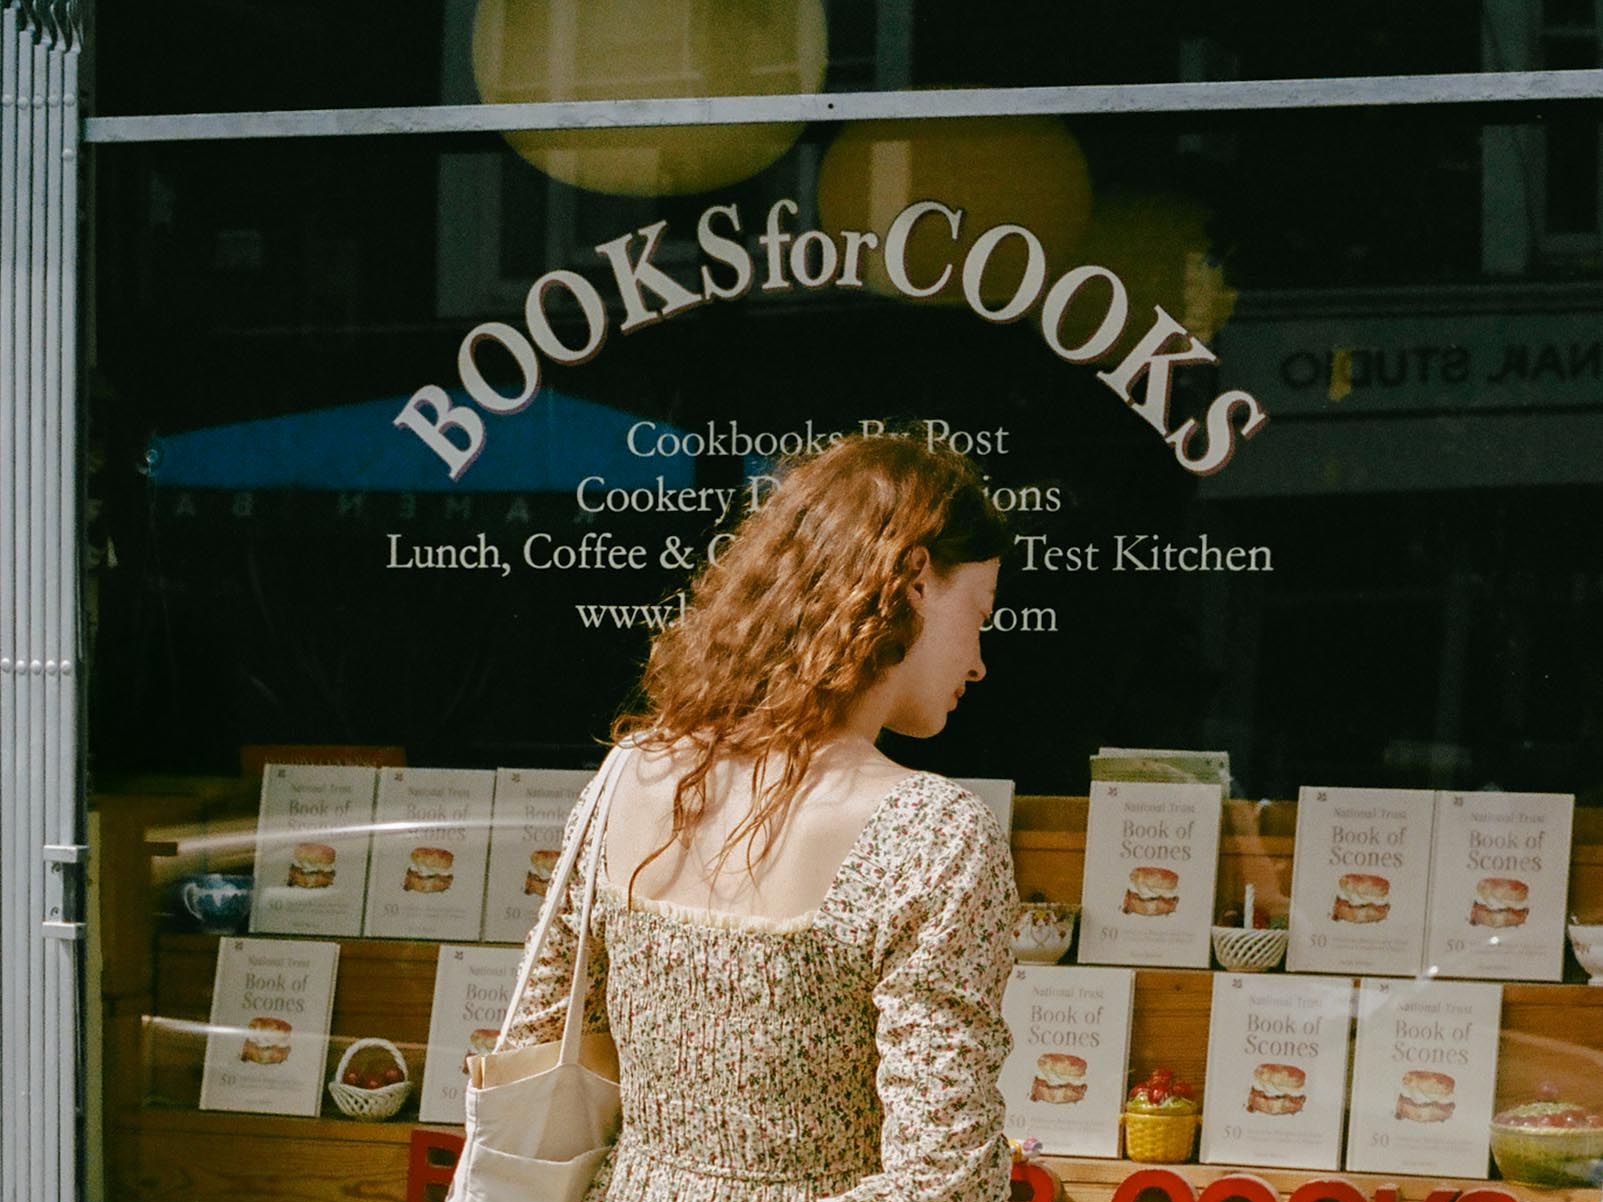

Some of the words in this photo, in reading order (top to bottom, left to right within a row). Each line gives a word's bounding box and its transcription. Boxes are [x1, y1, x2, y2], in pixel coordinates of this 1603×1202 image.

[393, 203, 753, 481] BOOKS
[760, 199, 878, 290] for
[885, 200, 1268, 476] COOKS
[626, 419, 844, 458] Cookbooks
[858, 419, 911, 441] B
[923, 418, 1010, 456] Post
[577, 475, 736, 527] Cookery
[387, 532, 511, 577] Lunch,
[523, 532, 647, 570] Coffee
[659, 535, 695, 570] &
[1014, 534, 1100, 572] Test
[1112, 533, 1274, 572] Kitchen
[289, 799, 328, 817] Book
[407, 803, 446, 820] Book
[452, 803, 469, 820] of
[1123, 819, 1169, 839] Book
[1175, 820, 1195, 840] of
[1331, 825, 1380, 845] Book
[1387, 826, 1408, 846] of
[1469, 830, 1519, 849] Book
[1525, 830, 1546, 850] of
[1120, 840, 1192, 861] Scones
[1328, 845, 1404, 868] Scones
[1466, 849, 1543, 872] Scones
[245, 972, 286, 992] Book
[292, 974, 311, 993] of
[466, 983, 508, 1002] Book
[241, 990, 305, 1013] Scones
[1030, 1005, 1078, 1025] Book
[1084, 1005, 1104, 1025] of
[1248, 1013, 1296, 1034] Book
[1303, 1015, 1323, 1035] of
[1027, 1025, 1101, 1048] Scones
[1394, 1019, 1446, 1041] Book
[1452, 1021, 1473, 1042] of
[1243, 1034, 1320, 1058] Scones
[1391, 1040, 1469, 1065] Scones
